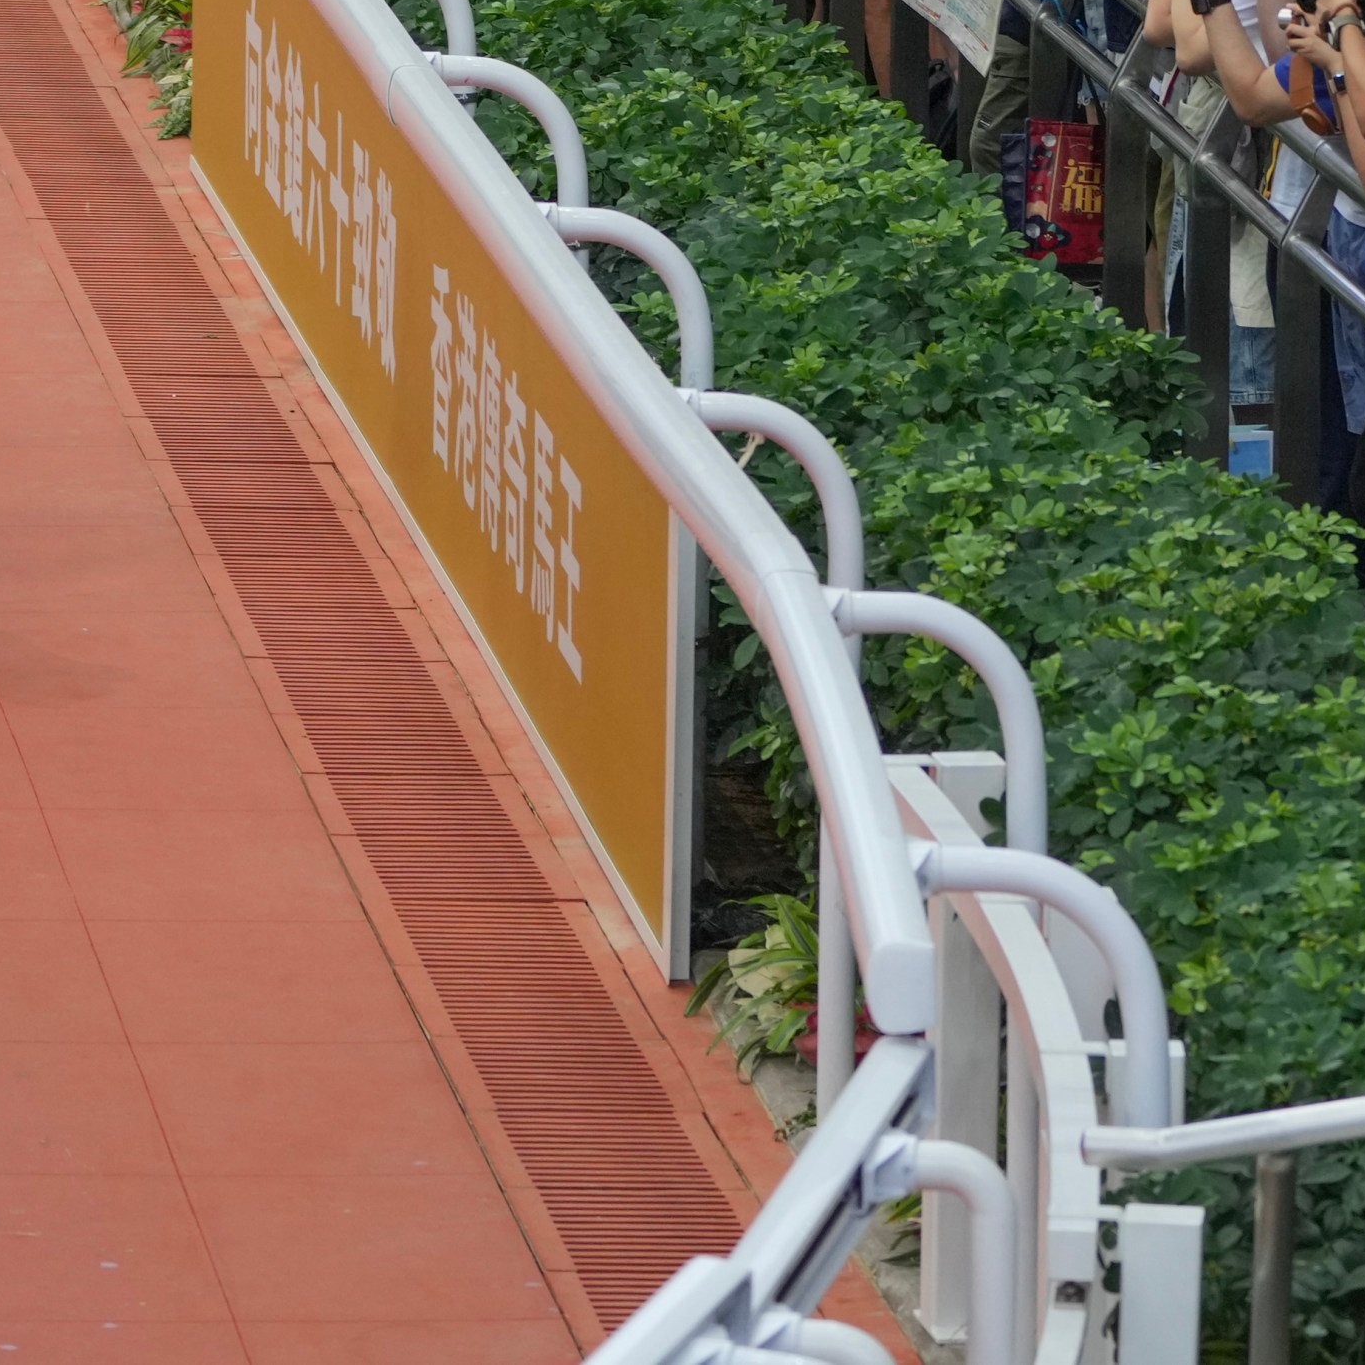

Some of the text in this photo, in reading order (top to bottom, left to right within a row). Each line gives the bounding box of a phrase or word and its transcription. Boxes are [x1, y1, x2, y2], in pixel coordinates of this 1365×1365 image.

[430, 264, 584, 685] 香港傳奇馬王
